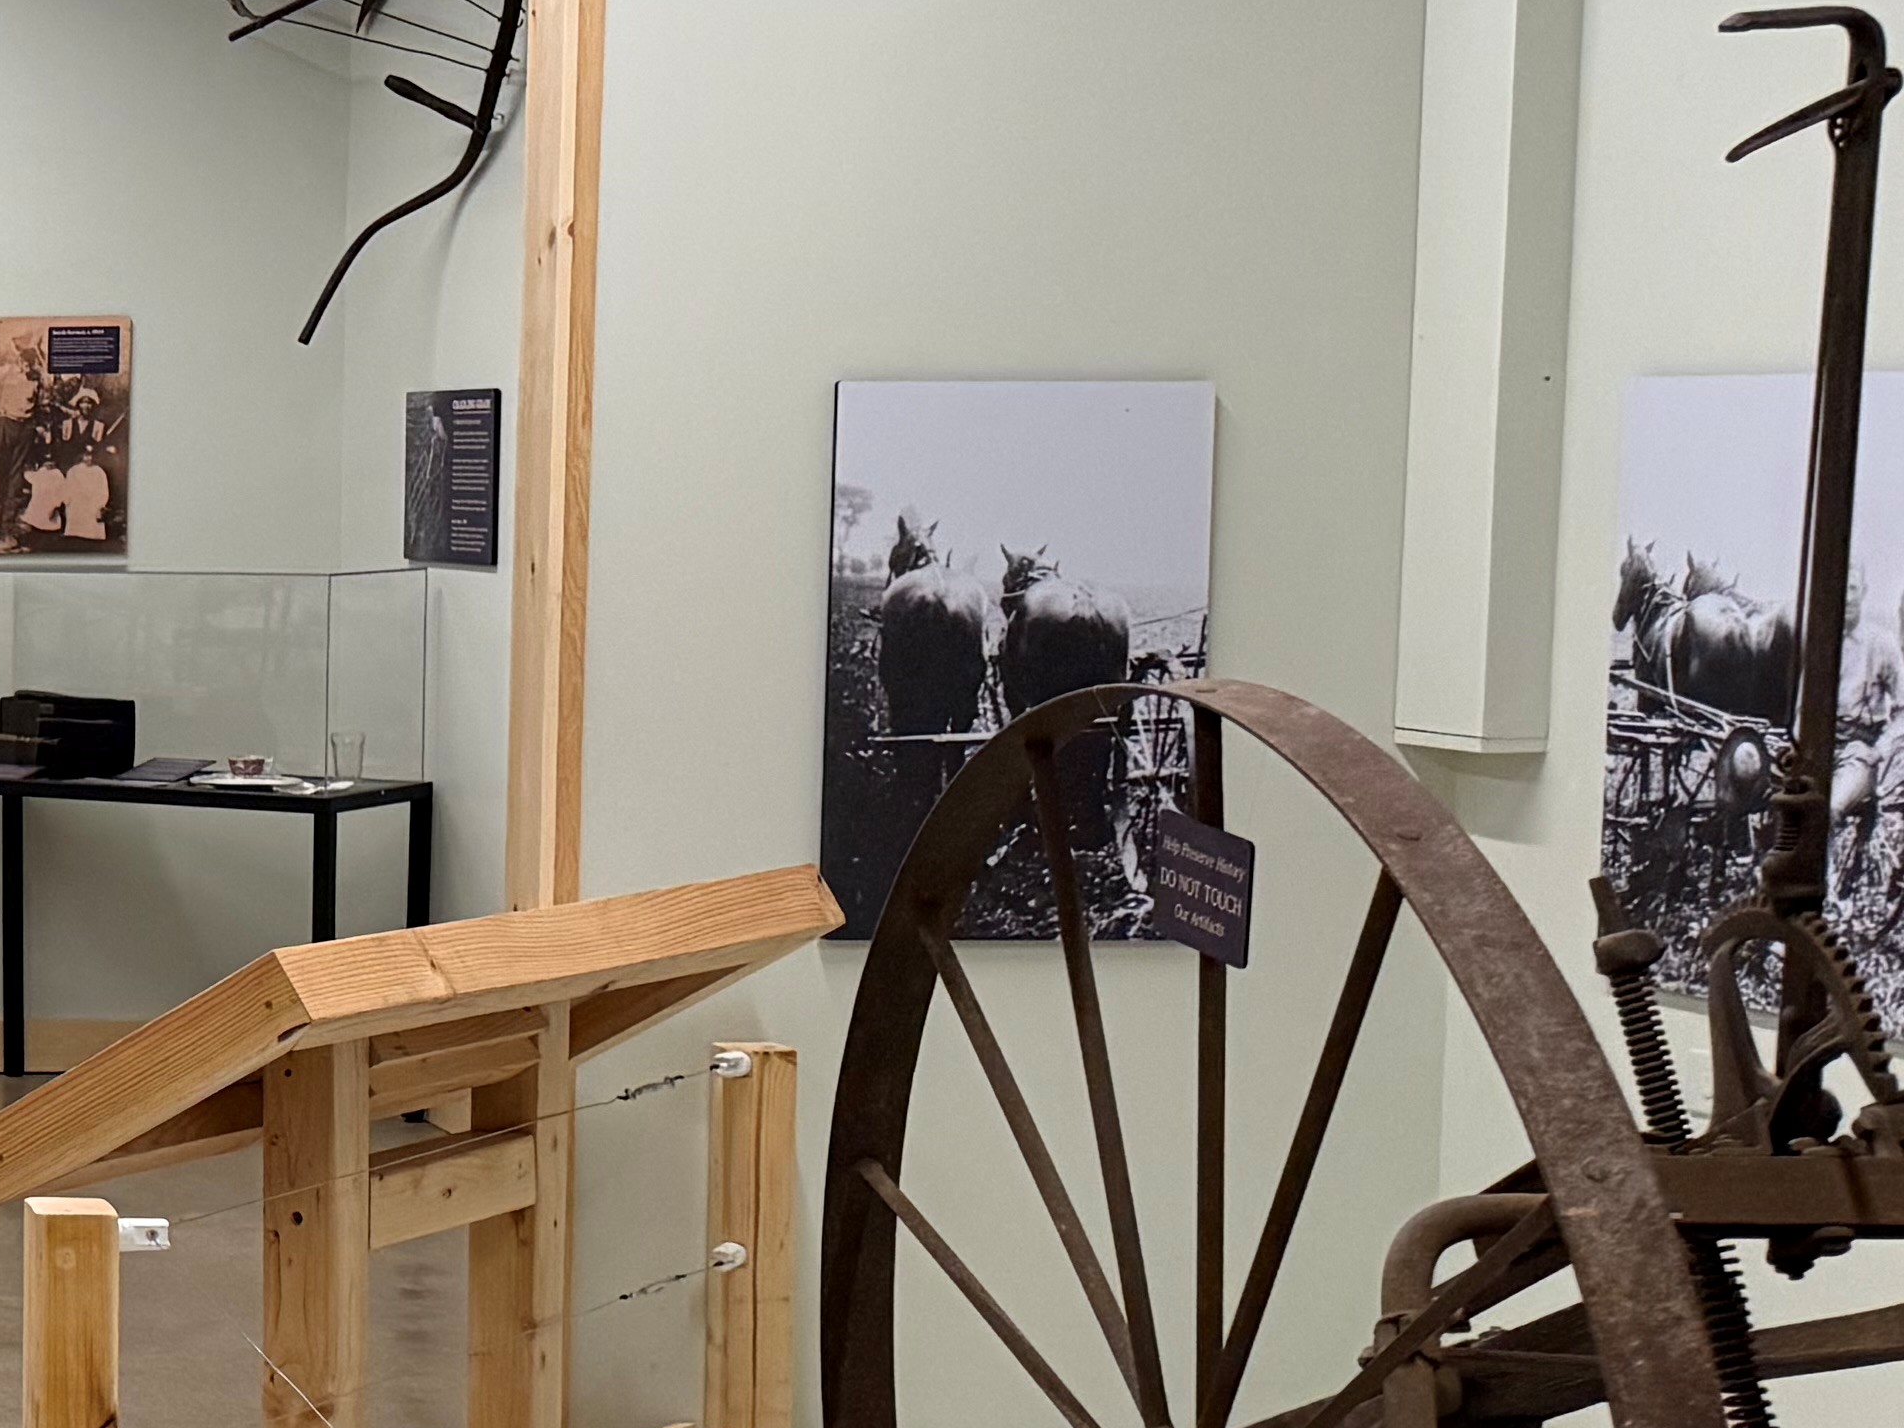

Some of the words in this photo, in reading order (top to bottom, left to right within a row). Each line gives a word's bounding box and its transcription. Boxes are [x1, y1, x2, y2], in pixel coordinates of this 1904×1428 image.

[1162, 835, 1181, 856] Help
[1181, 842, 1215, 868] Preserve
[1216, 856, 1246, 883] History
[1160, 866, 1177, 888] DO
[1178, 873, 1201, 900] NOT
[1204, 884, 1243, 918] TOUCH
[1174, 903, 1190, 922] Our
[1190, 912, 1226, 938] Artifacts
